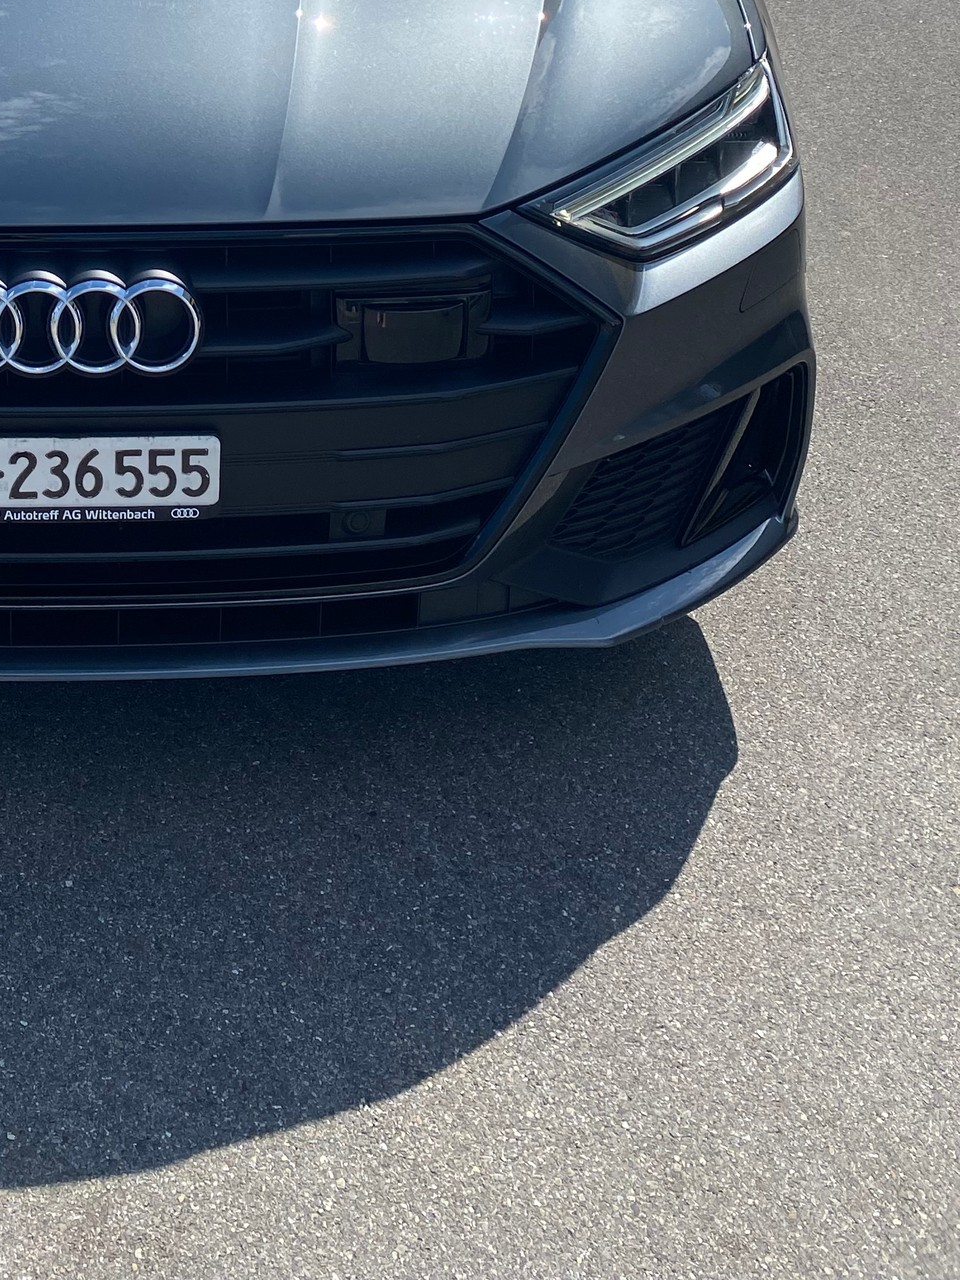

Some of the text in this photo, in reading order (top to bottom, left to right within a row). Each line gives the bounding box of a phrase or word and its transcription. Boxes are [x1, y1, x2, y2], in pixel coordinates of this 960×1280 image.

[3, 509, 59, 521] Autotreff
[62, 509, 82, 521] AG
[85, 508, 155, 520] Wittenbach
